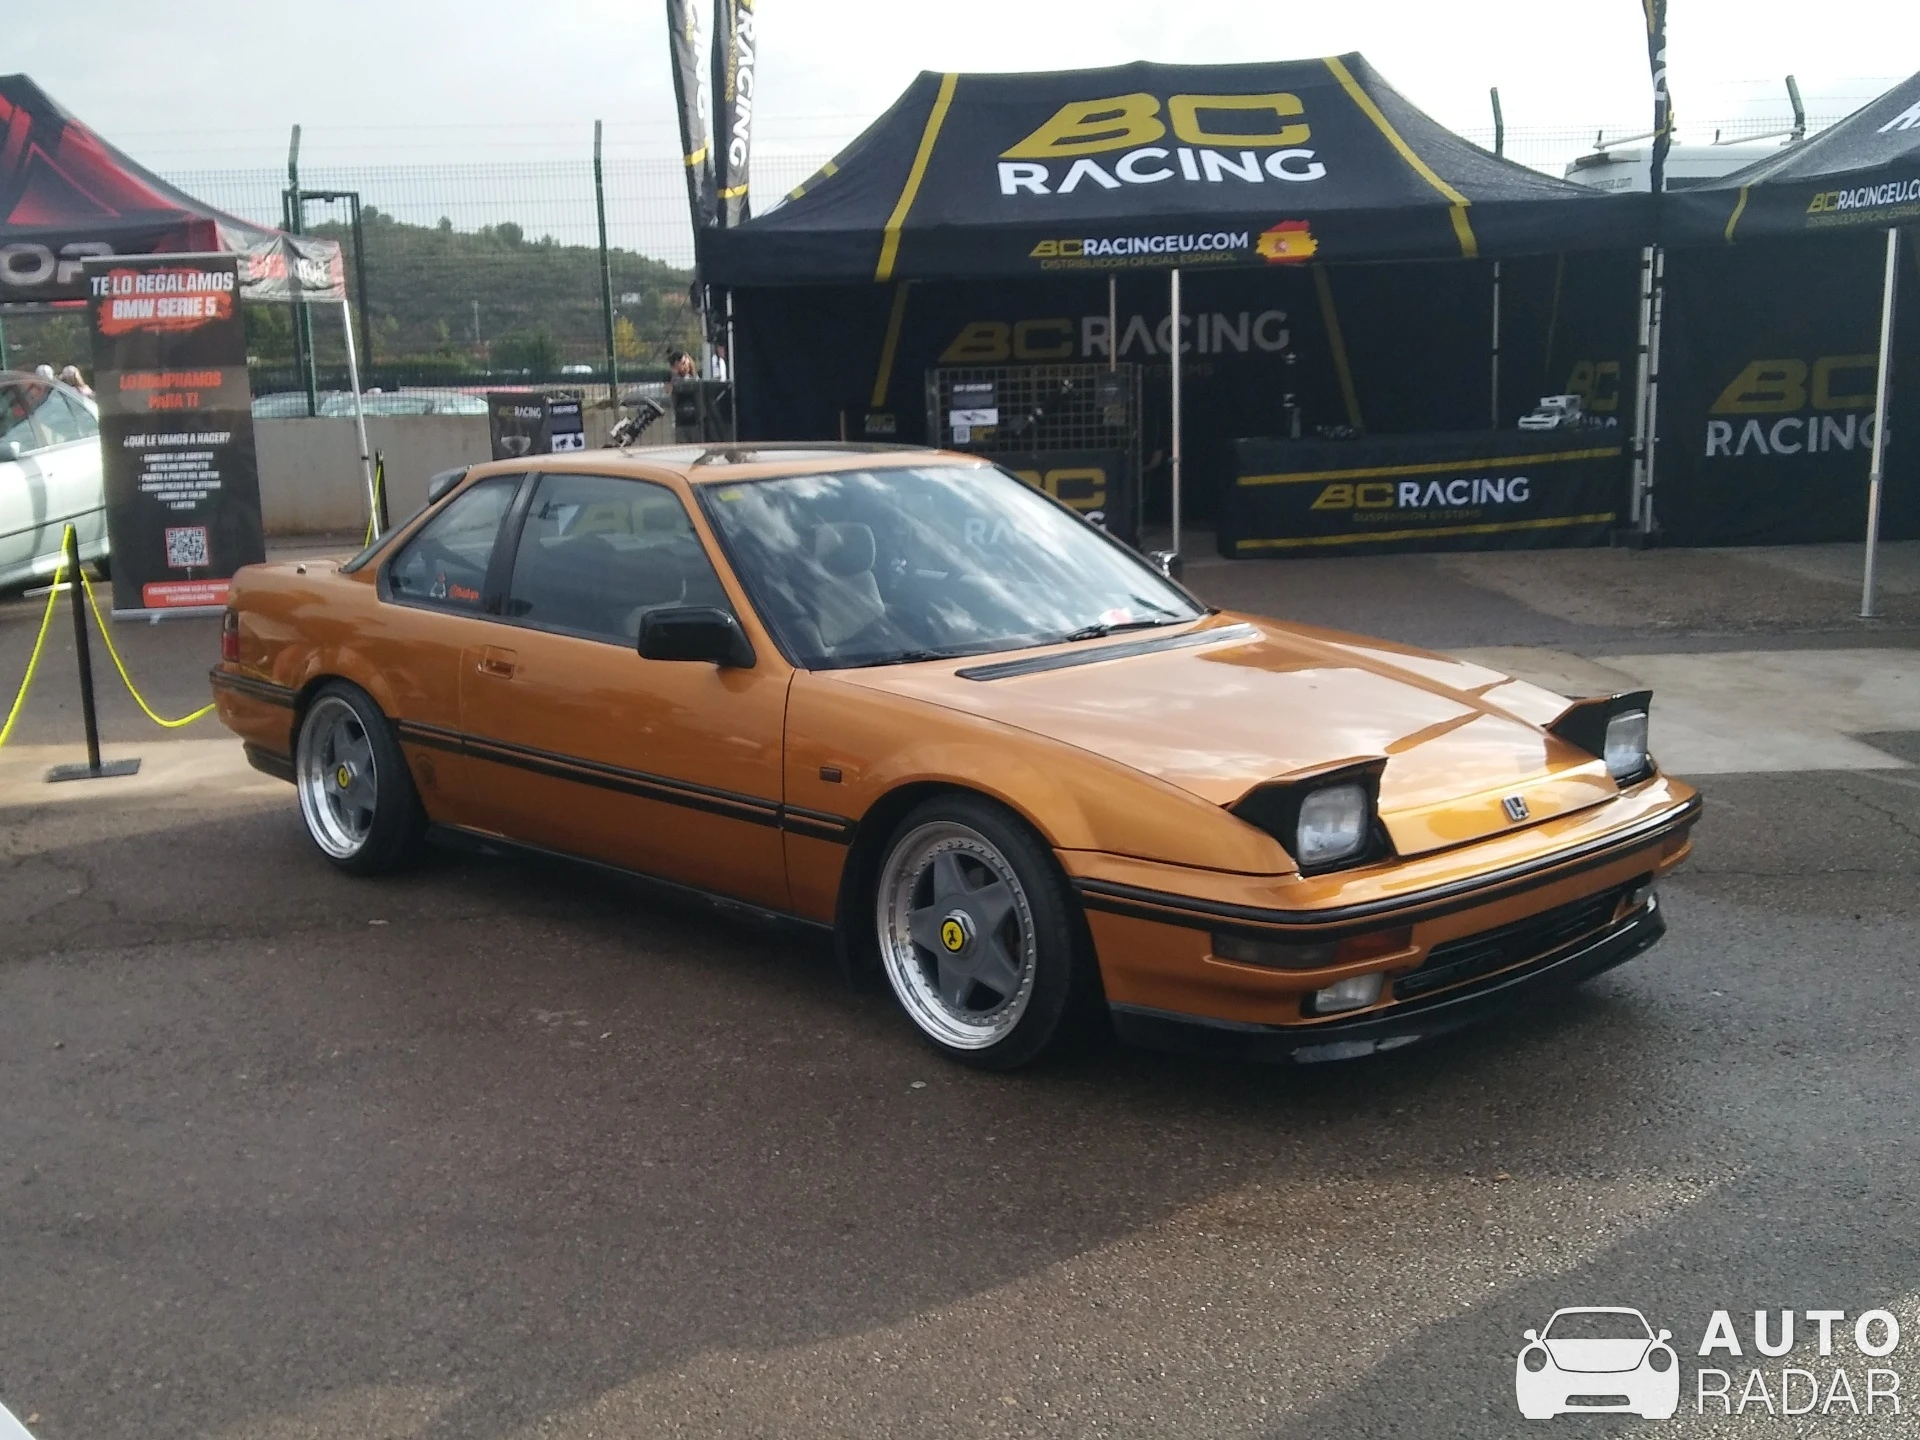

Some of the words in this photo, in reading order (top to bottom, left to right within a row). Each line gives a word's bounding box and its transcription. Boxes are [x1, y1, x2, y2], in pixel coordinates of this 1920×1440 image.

[728, 8, 757, 168] RACING
[999, 92, 1312, 158] BC
[997, 147, 1328, 195] RACING
[1040, 257, 1125, 270] DISTRIBUIDOR
[1129, 256, 1175, 267] OFICIAL
[1180, 252, 1237, 265] ESPAÑOL
[90, 274, 110, 296] TE
[112, 274, 132, 295] LO
[134, 271, 235, 294] REGALAMOS
[112, 298, 155, 320] BMW
[156, 296, 203, 319] SERIE
[205, 296, 217, 318] 5
[1080, 308, 1290, 357] RACING
[158, 432, 188, 447] VAMOS
[189, 432, 197, 446] A
[197, 431, 231, 446] HACER?
[1398, 476, 1531, 509] RACING
